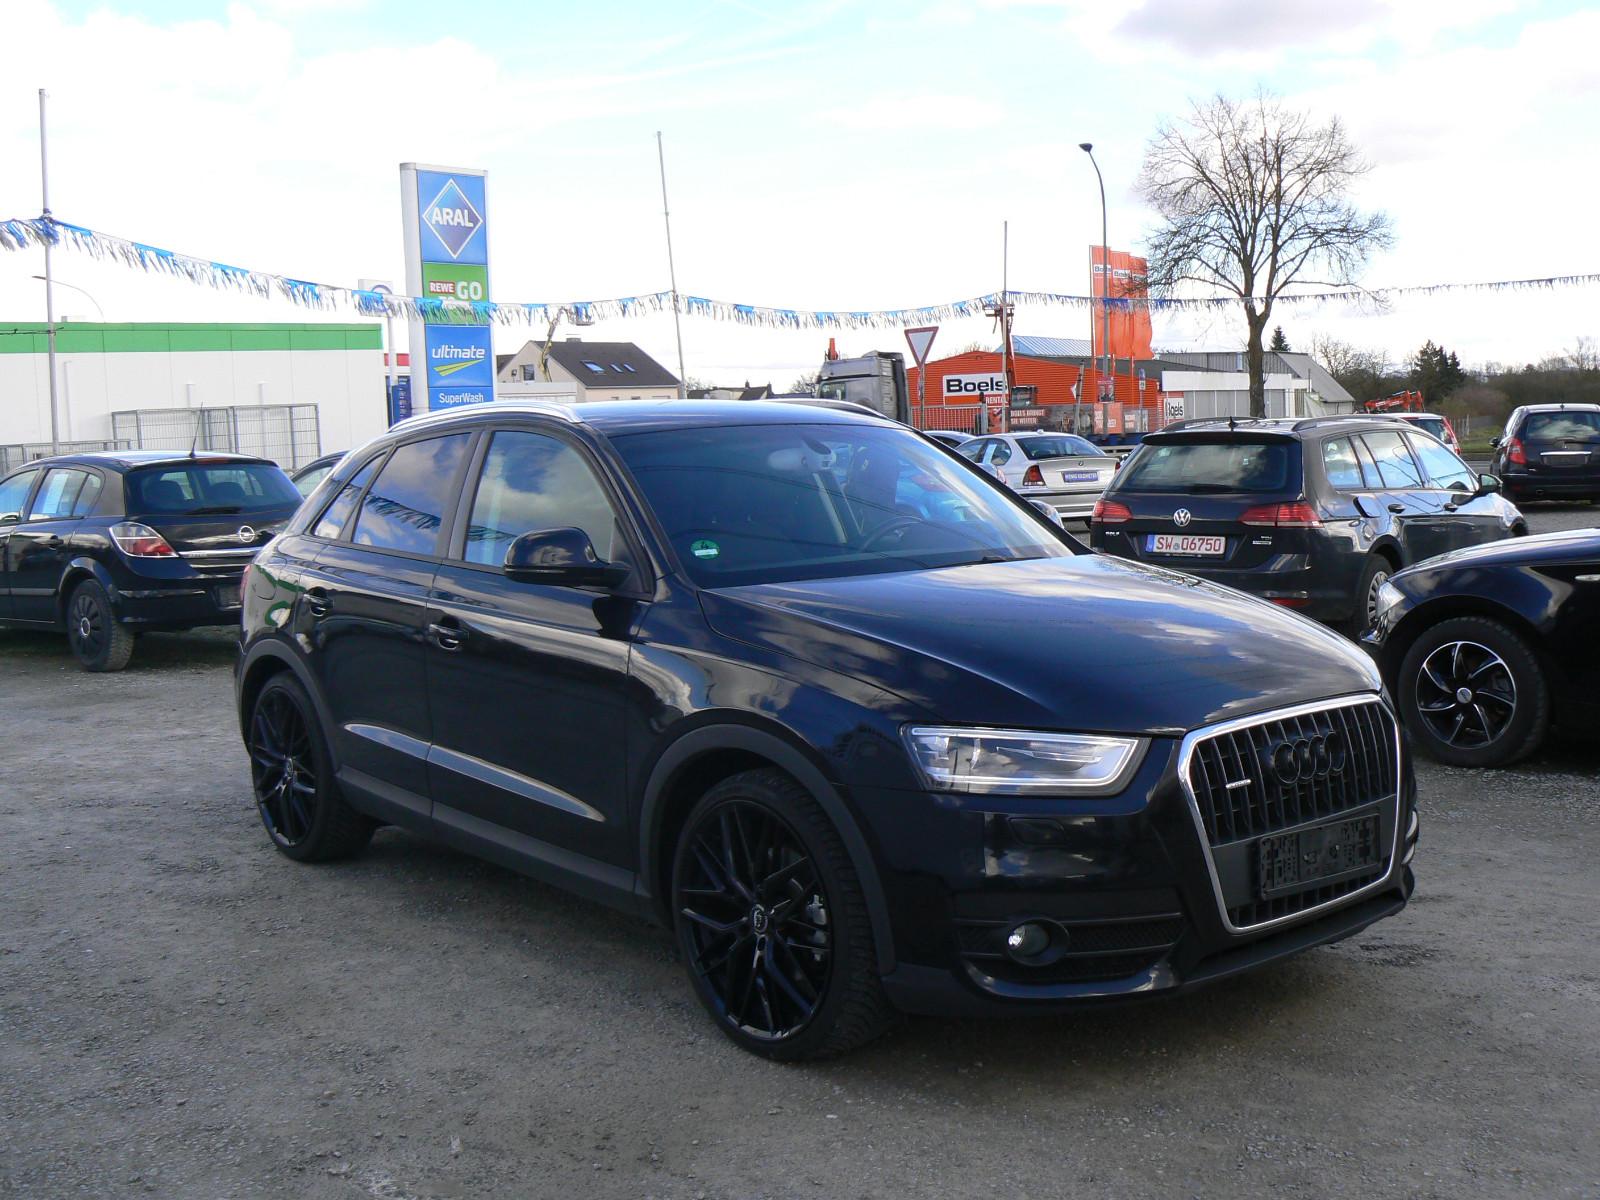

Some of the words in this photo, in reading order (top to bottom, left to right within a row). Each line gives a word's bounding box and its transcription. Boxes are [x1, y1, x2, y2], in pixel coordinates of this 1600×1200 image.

[431, 207, 474, 228] ARAL
[430, 282, 455, 293] REWE
[456, 281, 482, 301] GO
[432, 345, 485, 360] ultimate
[946, 377, 1007, 393] Boels
[439, 392, 484, 405] SuperWash
[1156, 536, 1174, 551] SW
[1181, 537, 1222, 552] 06750
